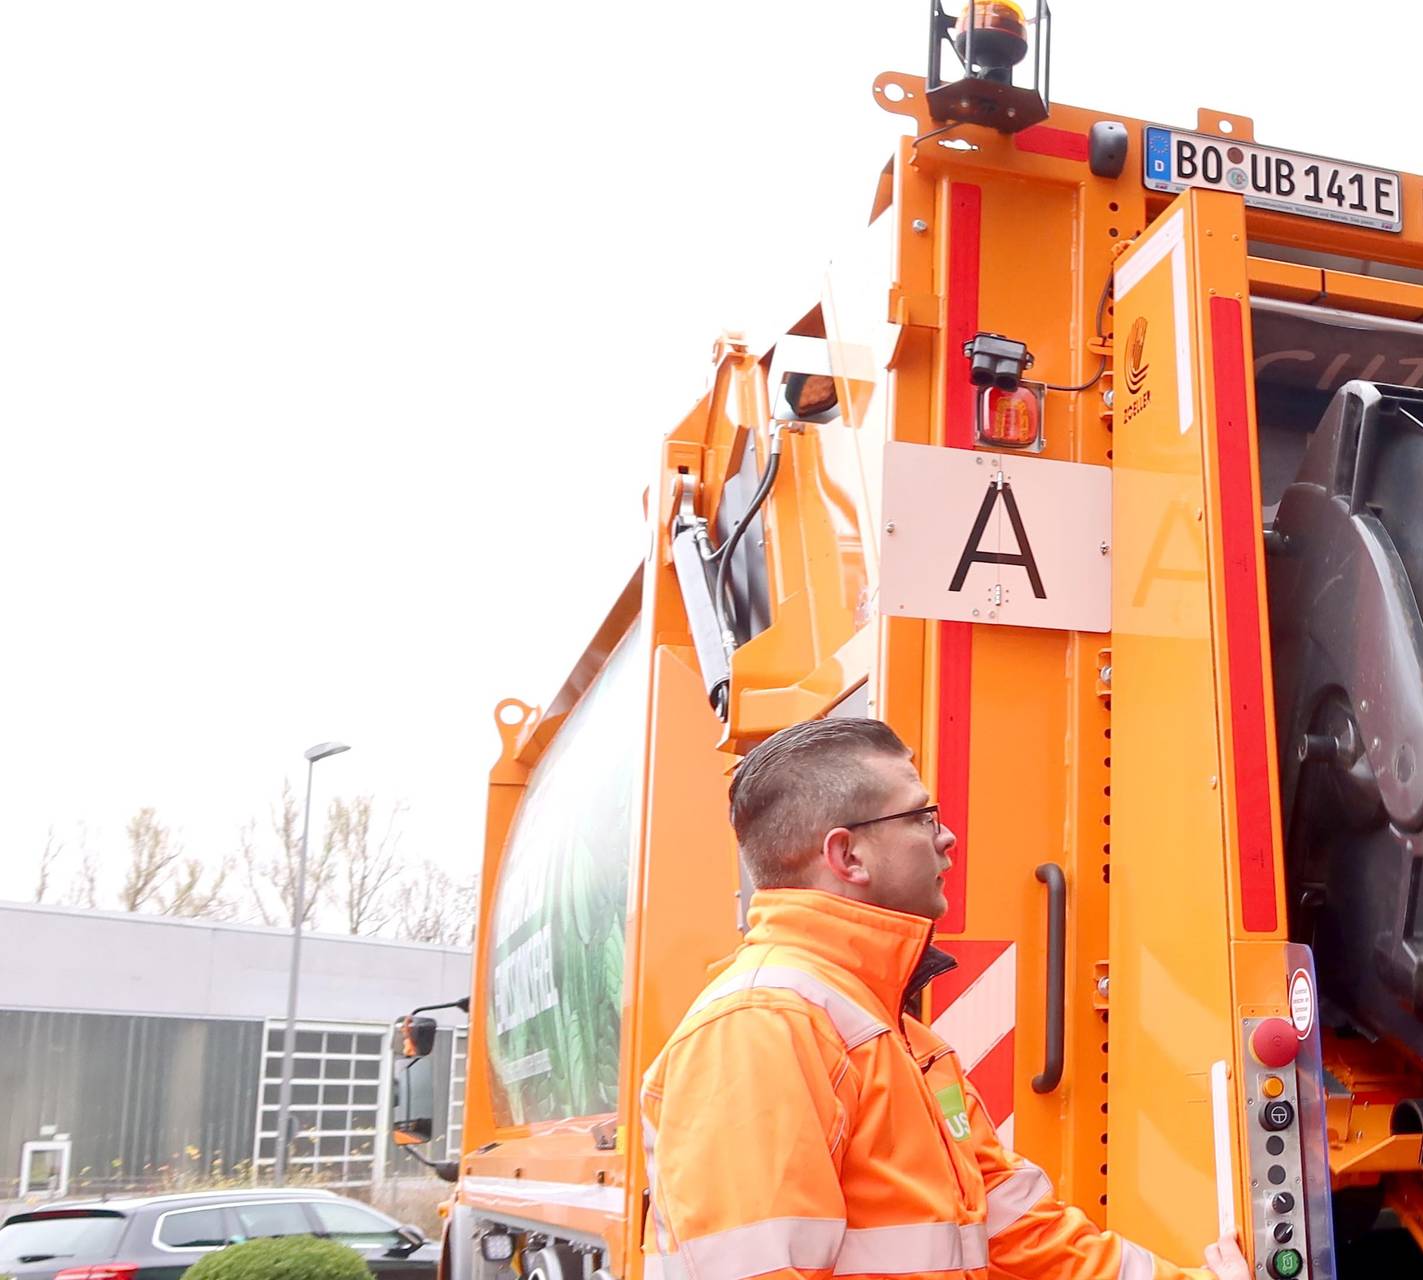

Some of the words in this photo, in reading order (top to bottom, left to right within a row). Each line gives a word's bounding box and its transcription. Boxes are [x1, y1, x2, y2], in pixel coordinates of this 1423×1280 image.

[1154, 160, 1165, 172] D
[1177, 140, 1223, 184] BO
[1251, 153, 1296, 196] UB
[948, 480, 1047, 600] A
